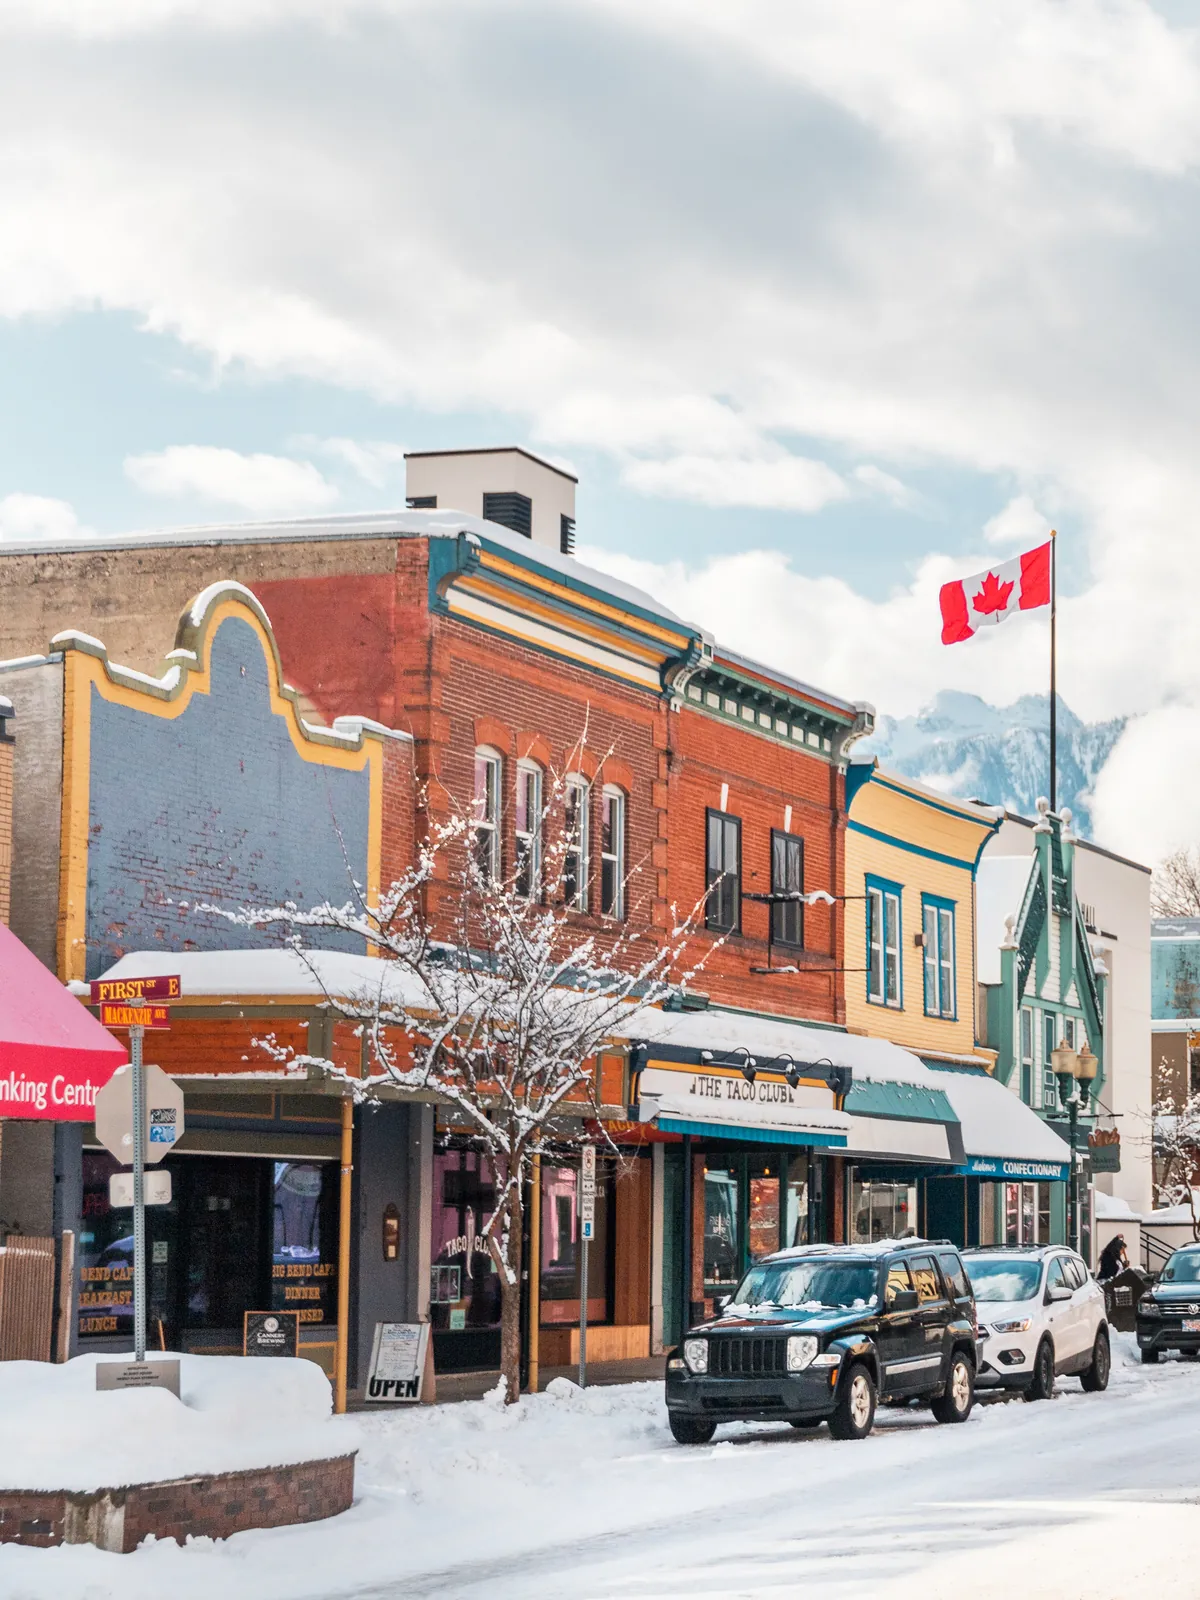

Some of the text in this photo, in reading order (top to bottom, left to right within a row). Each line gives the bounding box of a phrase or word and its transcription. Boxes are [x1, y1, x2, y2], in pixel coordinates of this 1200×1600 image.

[98, 978, 179, 1000] FIRST ST E
[104, 1006, 152, 1025] MACKENZIE
[51, 1075, 102, 1106] Centr
[698, 1076, 788, 1103] THE TACO CLUB
[1003, 1161, 1062, 1178] CONFECTIONARY
[445, 1235, 492, 1258] TACO CLU
[113, 1266, 135, 1281] CAF
[287, 1264, 312, 1277] BEND
[285, 1287, 320, 1300] DINNER
[79, 1316, 117, 1332] LUNCH
[369, 1375, 420, 1397] OPEN
